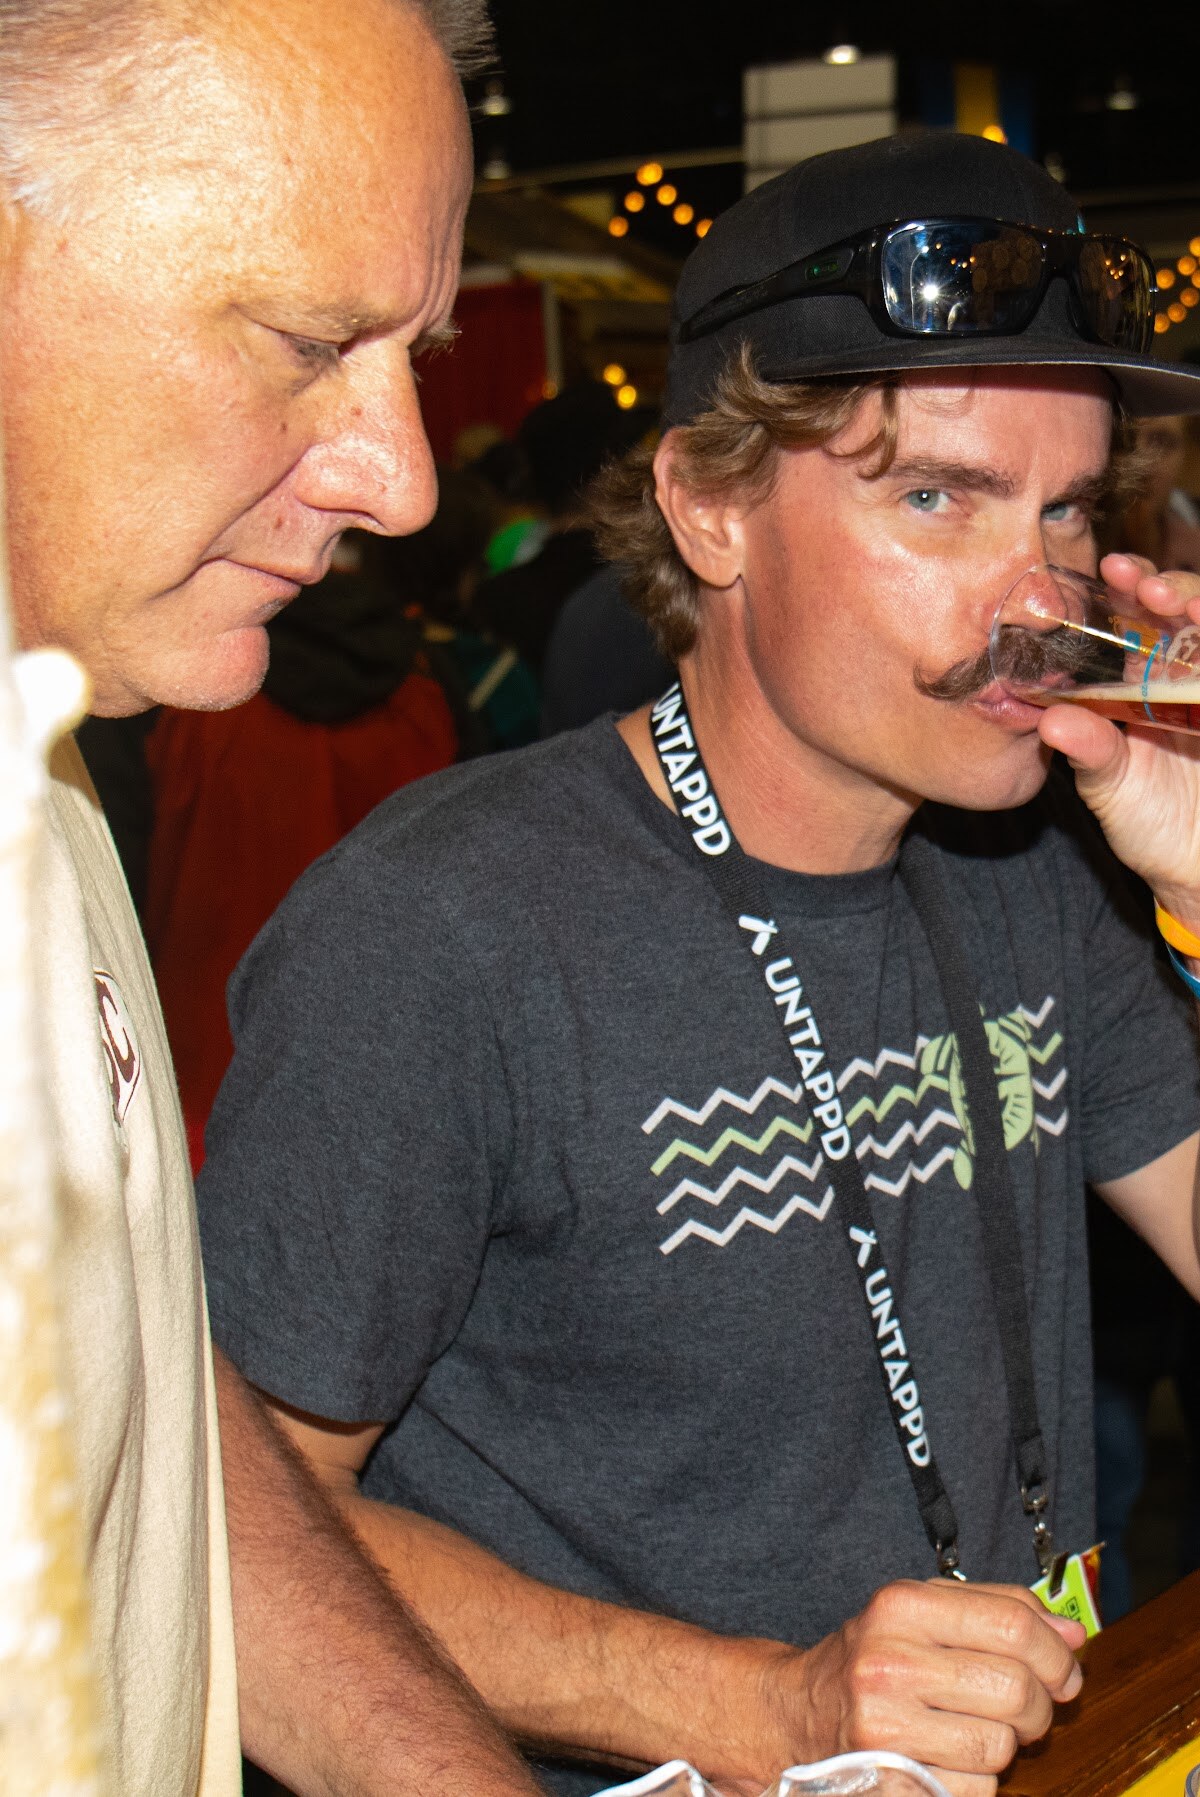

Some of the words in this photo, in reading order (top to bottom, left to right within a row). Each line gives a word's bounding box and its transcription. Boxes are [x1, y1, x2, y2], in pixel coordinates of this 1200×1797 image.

[651, 681, 732, 856] UNTAPPD
[765, 957, 851, 1161] UNTAPPD
[865, 1268, 931, 1467] UNTAPPD
